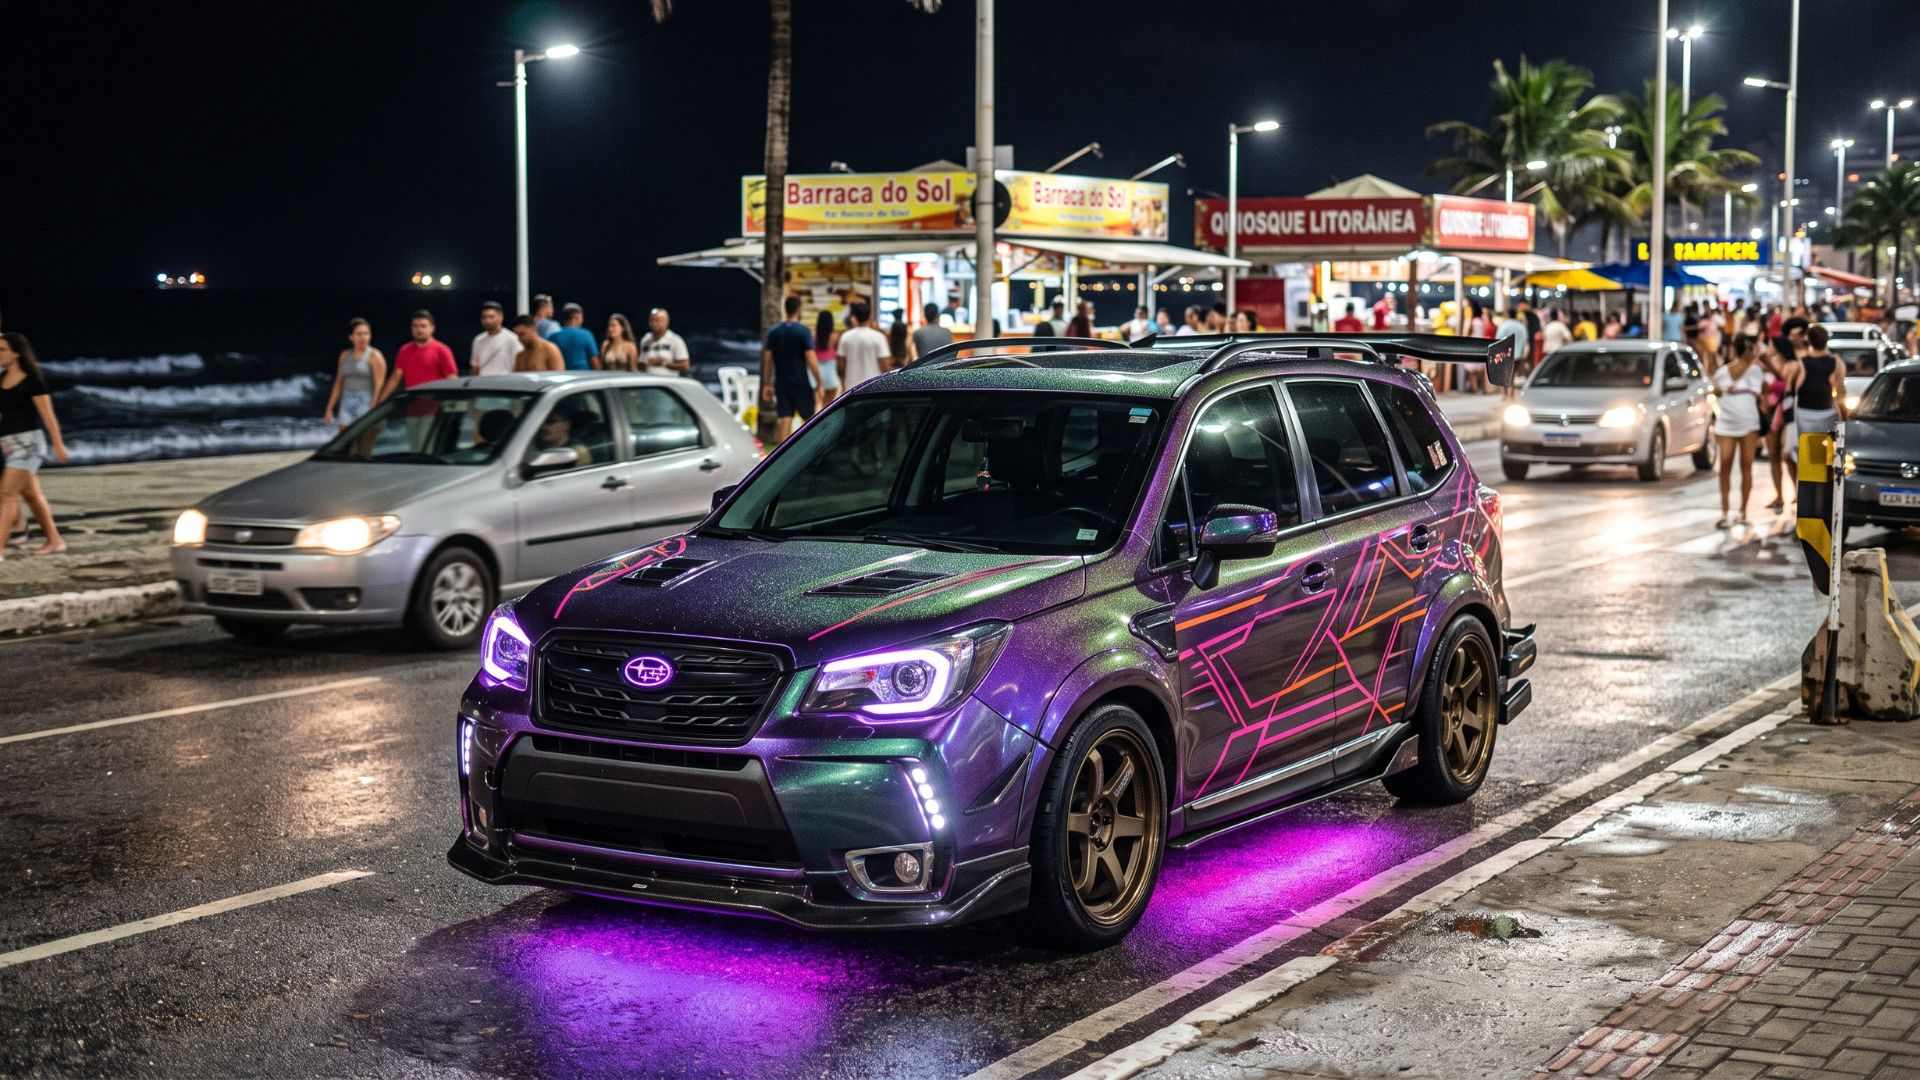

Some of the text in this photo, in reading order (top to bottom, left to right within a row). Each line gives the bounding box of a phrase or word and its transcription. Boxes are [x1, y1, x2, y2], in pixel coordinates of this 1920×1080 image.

[787, 178, 951, 205] Barraca do Sol
[1034, 181, 1127, 208] Barraca do Sol
[1310, 204, 1416, 233] LITORÂNEA
